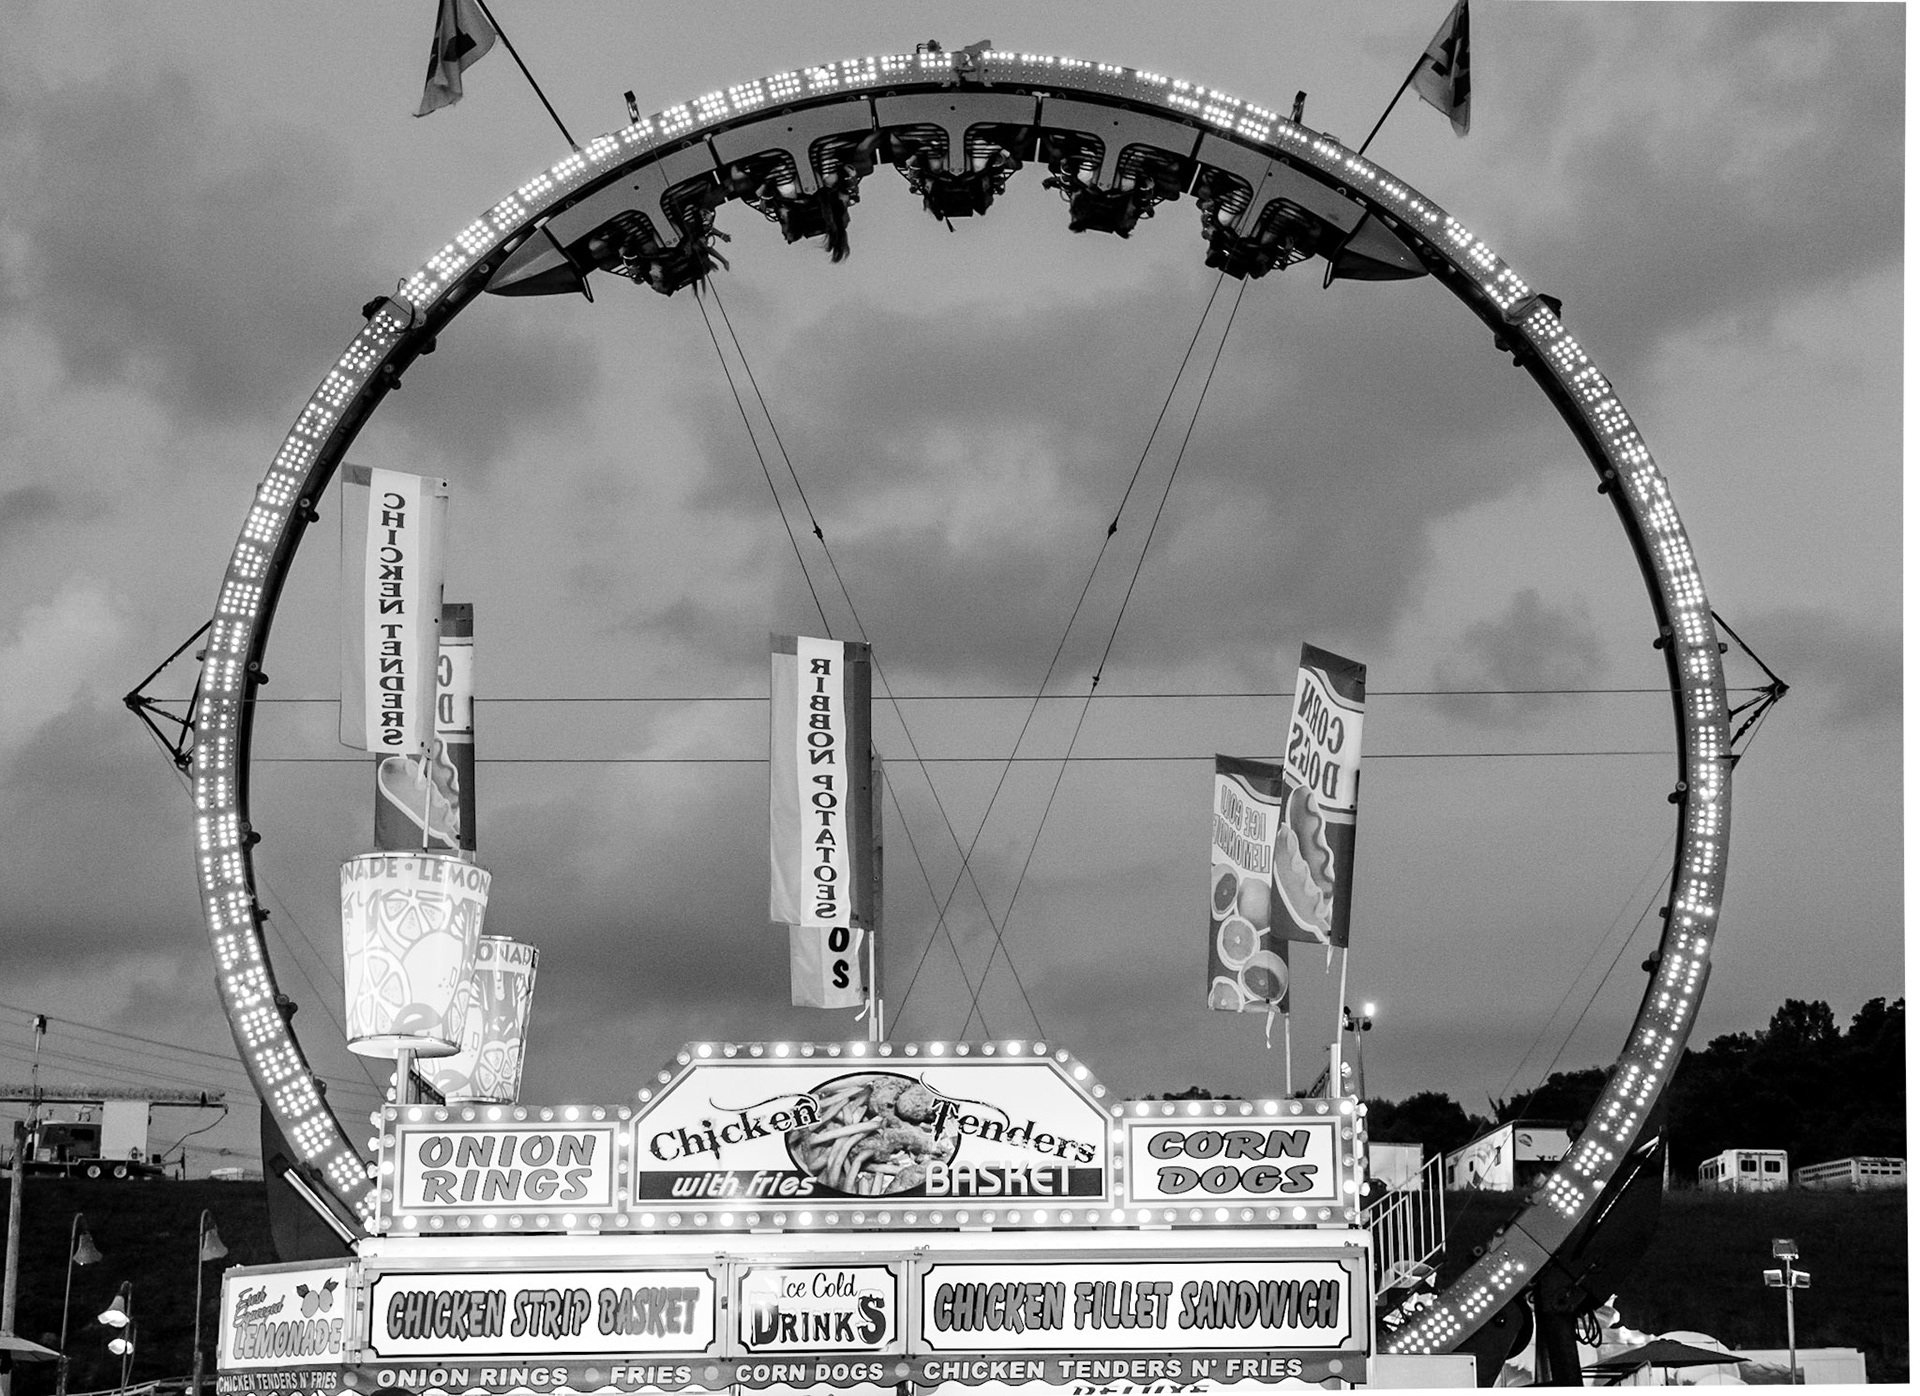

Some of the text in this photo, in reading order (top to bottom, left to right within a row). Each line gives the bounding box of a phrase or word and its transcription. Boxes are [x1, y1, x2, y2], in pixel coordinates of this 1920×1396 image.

[340, 858, 398, 885] NADE
[650, 1084, 1097, 1163] Chicken Tenders
[418, 1133, 597, 1168] ONION
[1148, 1129, 1312, 1160] CORN
[421, 1168, 593, 1204] RINGS
[671, 1160, 1077, 1197] with fries BASKET
[1157, 1164, 1319, 1194] DOGS
[779, 1272, 858, 1298] Ice Cold
[386, 1287, 701, 1342] CHICKEN STRIP BASKET
[750, 1289, 887, 1347] DRINKS
[933, 1280, 1340, 1335] CHICKEN FILLET SANDWICH
[233, 1318, 343, 1360] LEMONADE
[218, 1371, 338, 1392] CHICKEN TENDERS N' FRIES
[377, 1358, 1304, 1388] ONION RINGS FRIES CORN DOGS CHICKEN TENDERS N' FRIES
